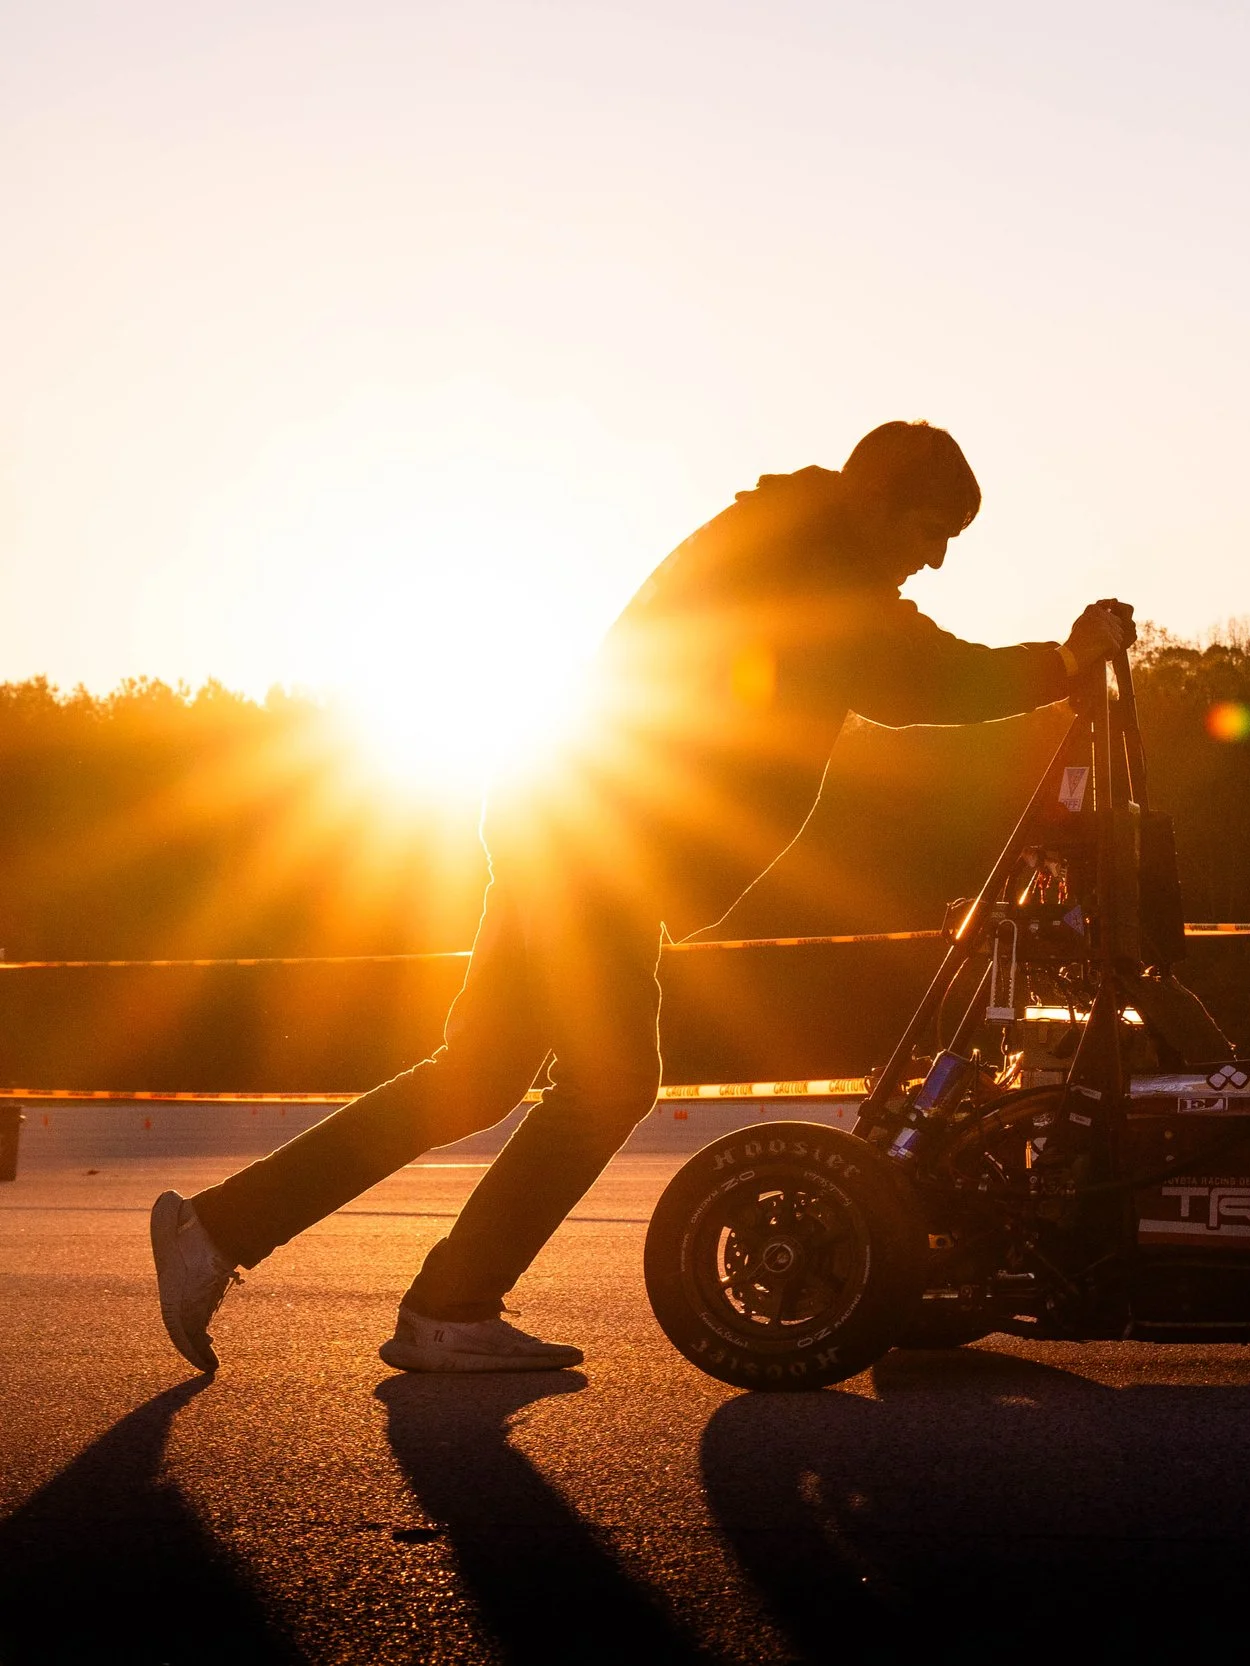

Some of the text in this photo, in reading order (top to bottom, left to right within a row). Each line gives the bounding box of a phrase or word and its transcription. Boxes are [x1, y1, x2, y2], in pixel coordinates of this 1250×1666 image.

[666, 1085, 700, 1097] CAUTION
[719, 1084, 753, 1096] CAUTION
[774, 1081, 808, 1095] CAUTION
